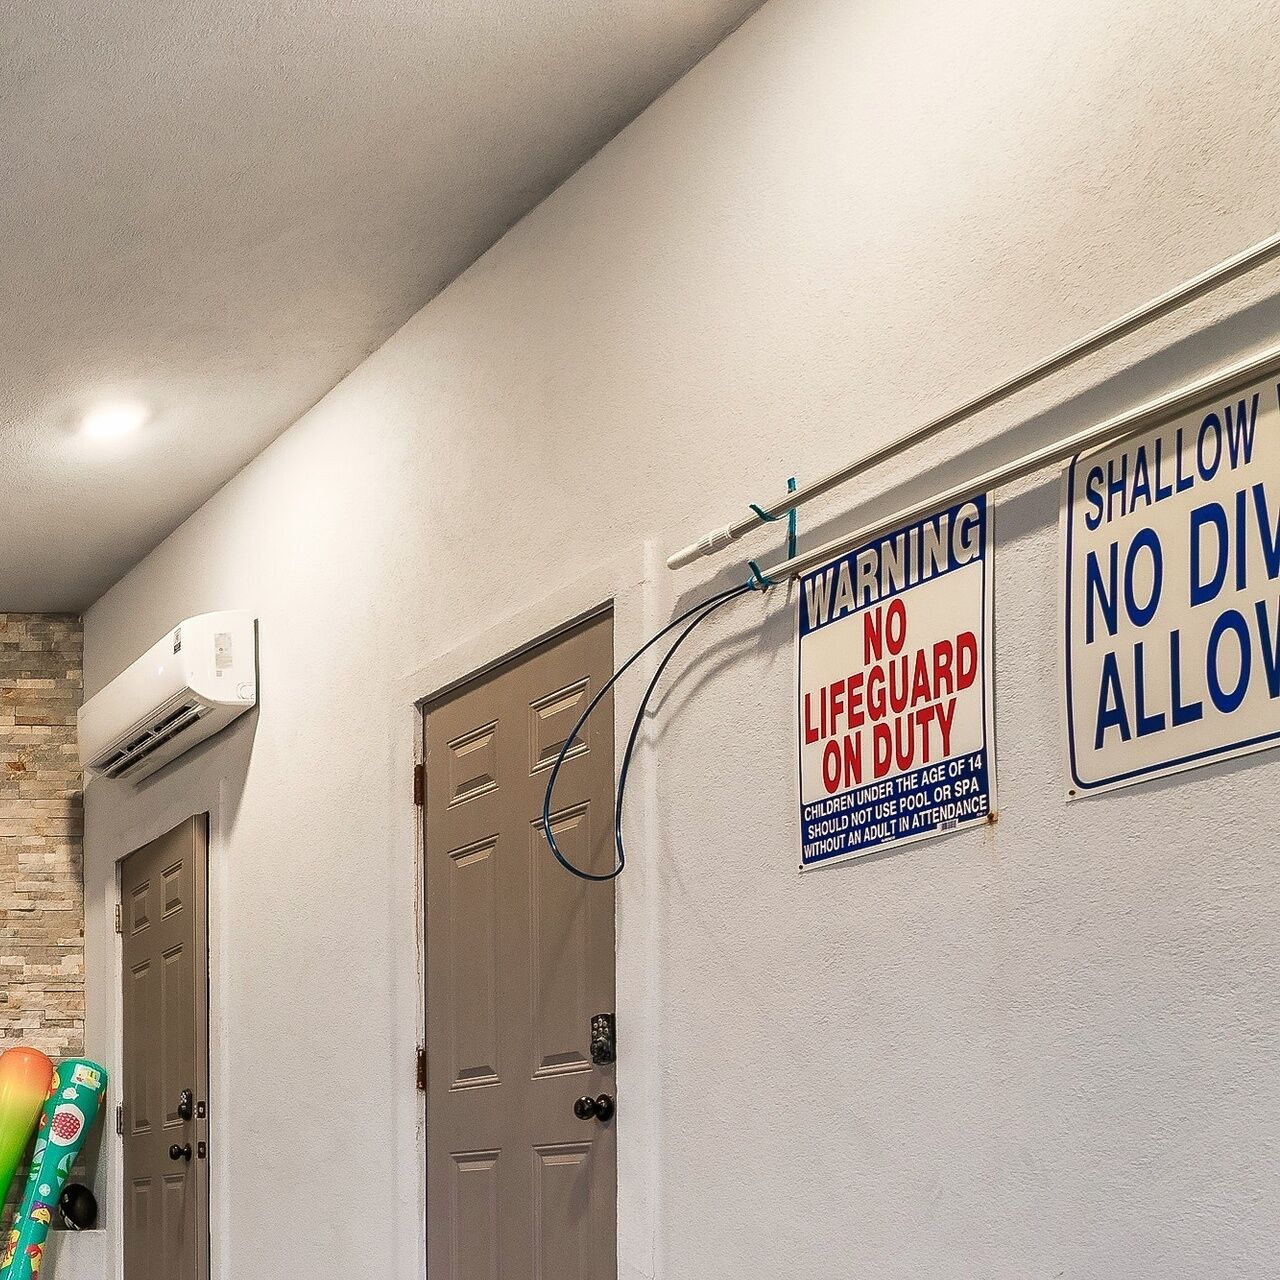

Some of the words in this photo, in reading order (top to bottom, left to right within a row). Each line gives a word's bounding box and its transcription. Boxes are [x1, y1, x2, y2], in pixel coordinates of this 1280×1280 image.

[1085, 392, 1259, 531] SHALLOW
[804, 501, 980, 629] WARNING
[1085, 527, 1163, 645] NO
[863, 598, 907, 666] NO
[804, 631, 978, 745] LIFEGUARD
[804, 793, 855, 821] CHILDREN
[857, 781, 894, 805] UNDER
[896, 775, 919, 793] THE
[921, 765, 946, 786] AGE
[948, 759, 965, 777] OF
[968, 754, 982, 772] 14
[822, 736, 862, 794] ON
[873, 698, 957, 780] DUTY
[803, 833, 846, 859] WITHOUT
[847, 829, 862, 847] AN
[863, 820, 897, 843] ADULT
[898, 816, 910, 833] IN
[912, 794, 988, 829] ATTENDANCE
[808, 815, 849, 840] SHOULD
[851, 807, 873, 825] NOT
[875, 802, 897, 820] USE
[899, 792, 931, 813] POOL
[933, 784, 952, 803] OR
[954, 777, 980, 798] SPA
